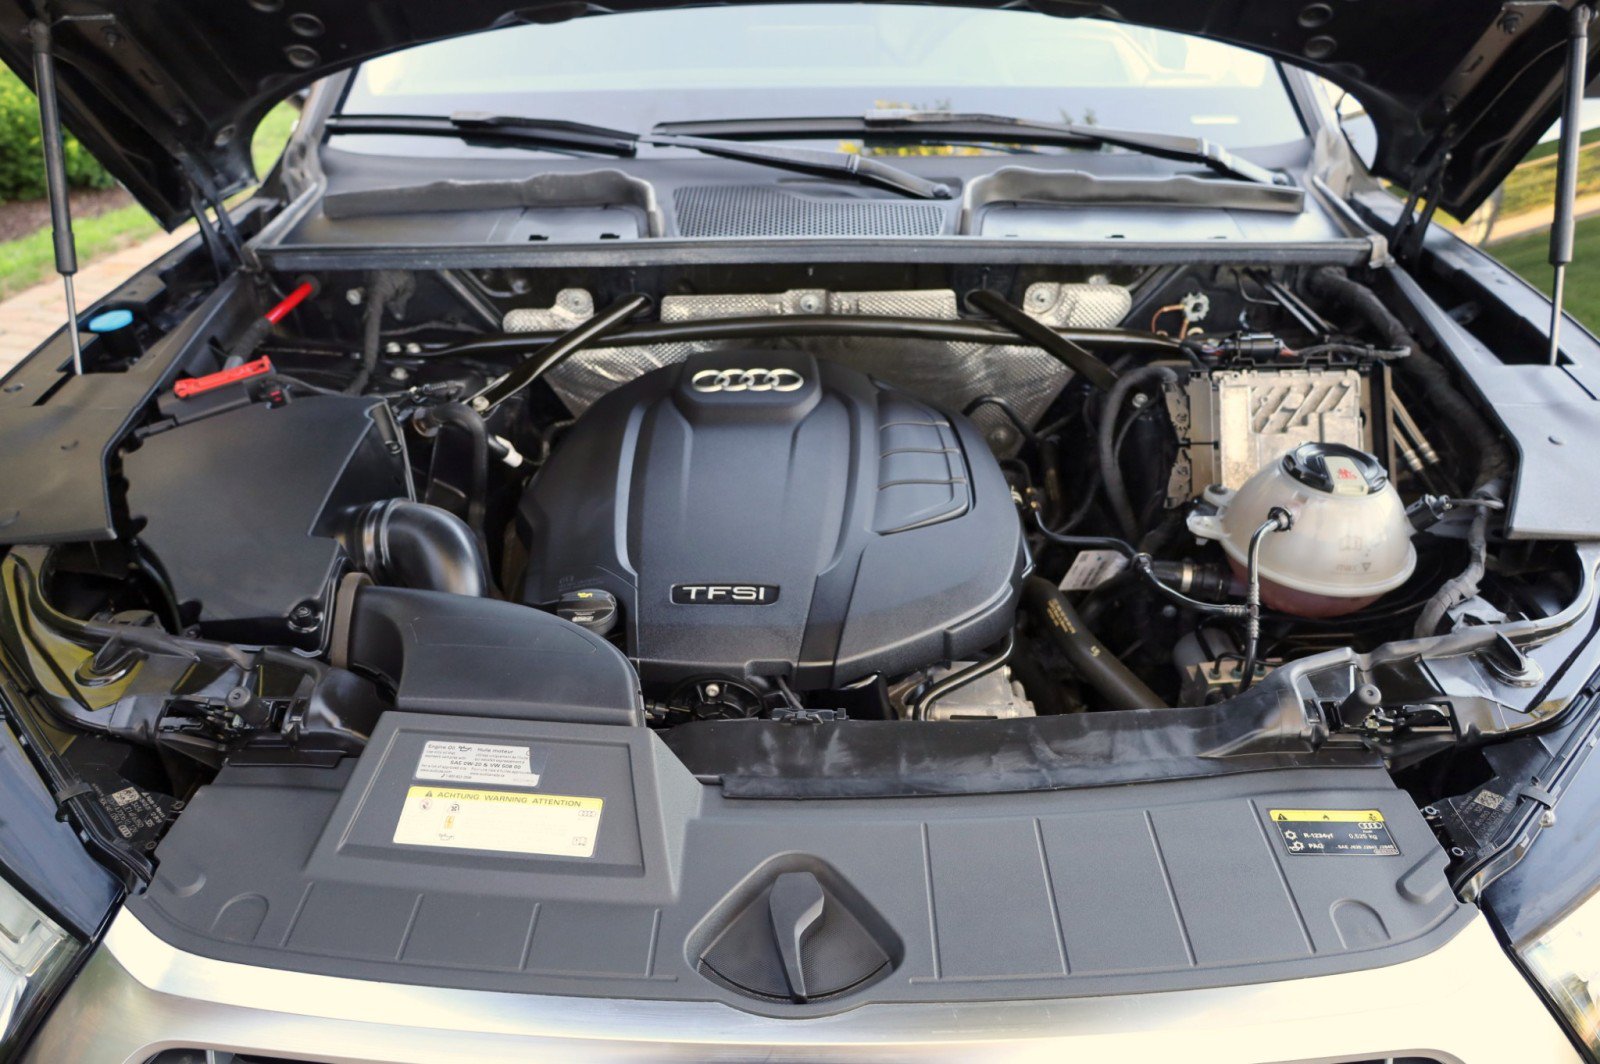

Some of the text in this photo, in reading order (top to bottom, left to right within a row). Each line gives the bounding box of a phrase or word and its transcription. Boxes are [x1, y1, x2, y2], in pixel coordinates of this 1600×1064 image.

[682, 586, 765, 600] TFSI
[437, 791, 582, 808] ACHTUNG WARNING ATTENTION
